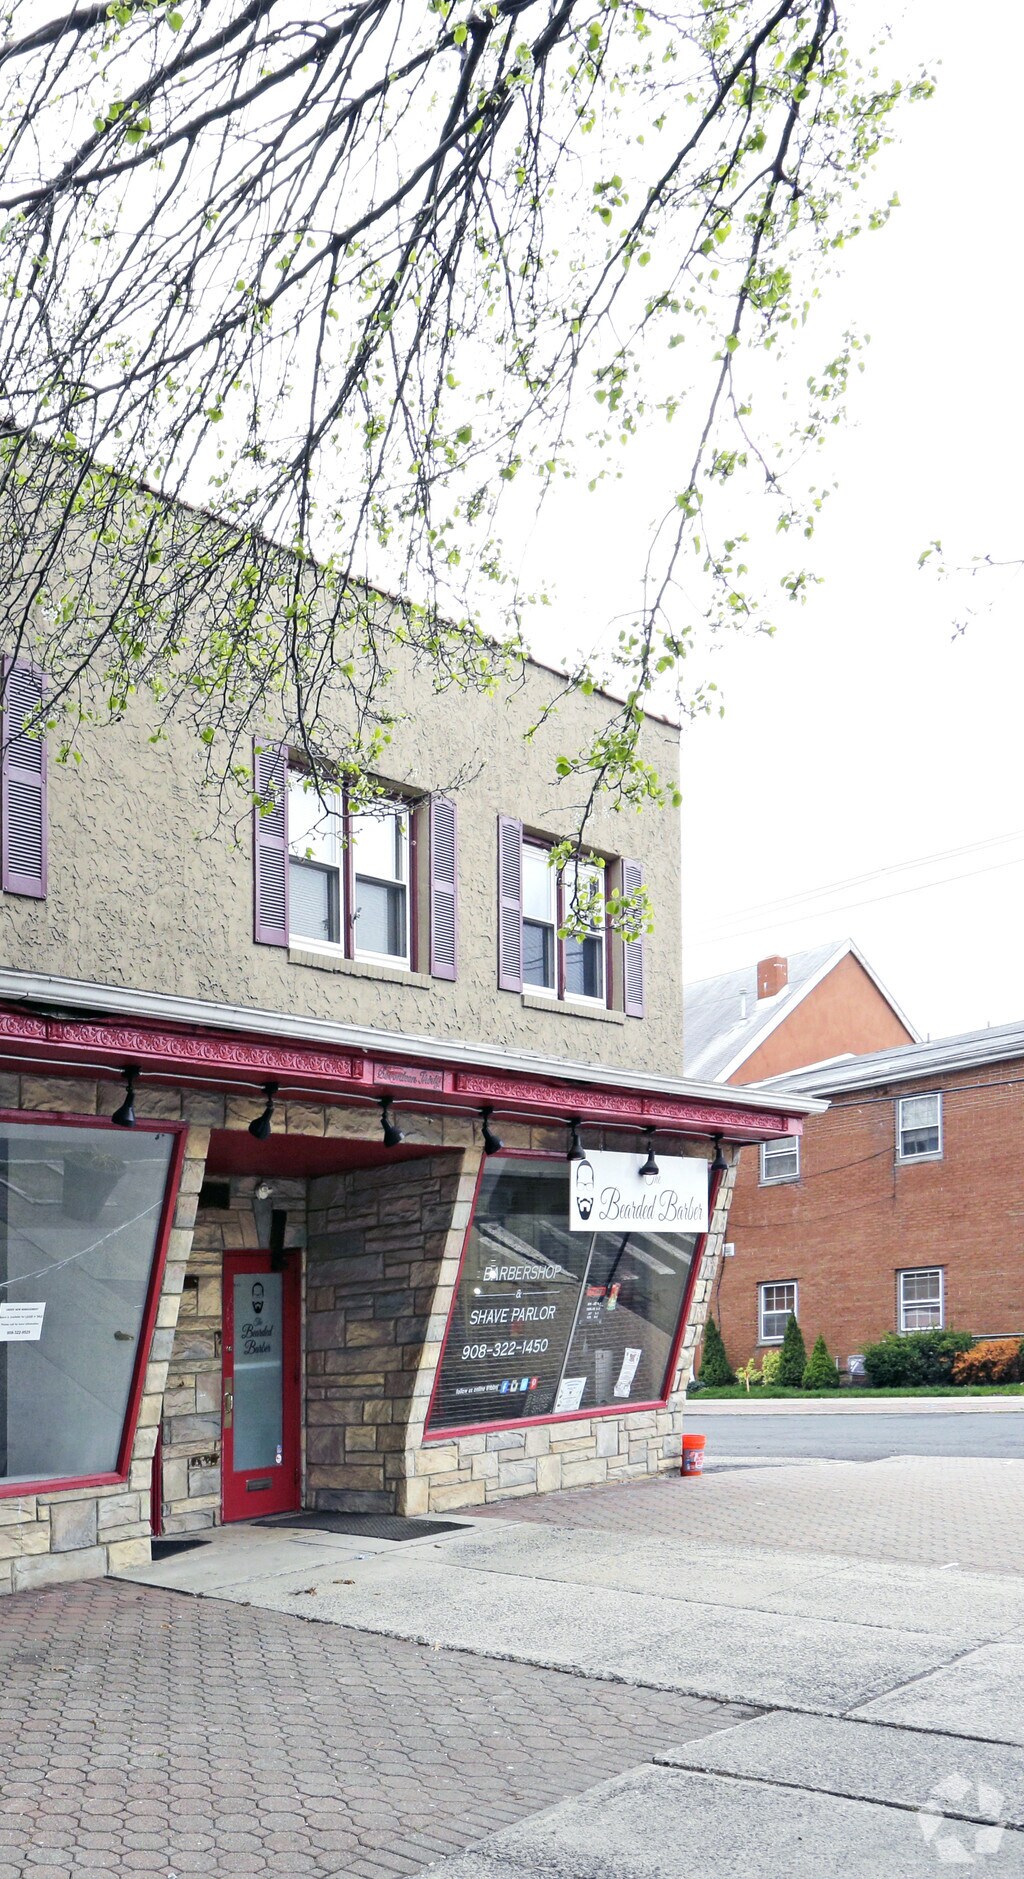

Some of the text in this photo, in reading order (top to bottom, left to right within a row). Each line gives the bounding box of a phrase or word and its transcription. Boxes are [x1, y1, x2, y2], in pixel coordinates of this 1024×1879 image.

[599, 1187, 702, 1221] Bearded Barber
[515, 1289, 522, 1298] &
[469, 1305, 556, 1324] SHAVE PARLOR
[241, 1323, 274, 1339] Bearded
[244, 1340, 271, 1355] Barber
[461, 1338, 549, 1360] 908-322-1450
